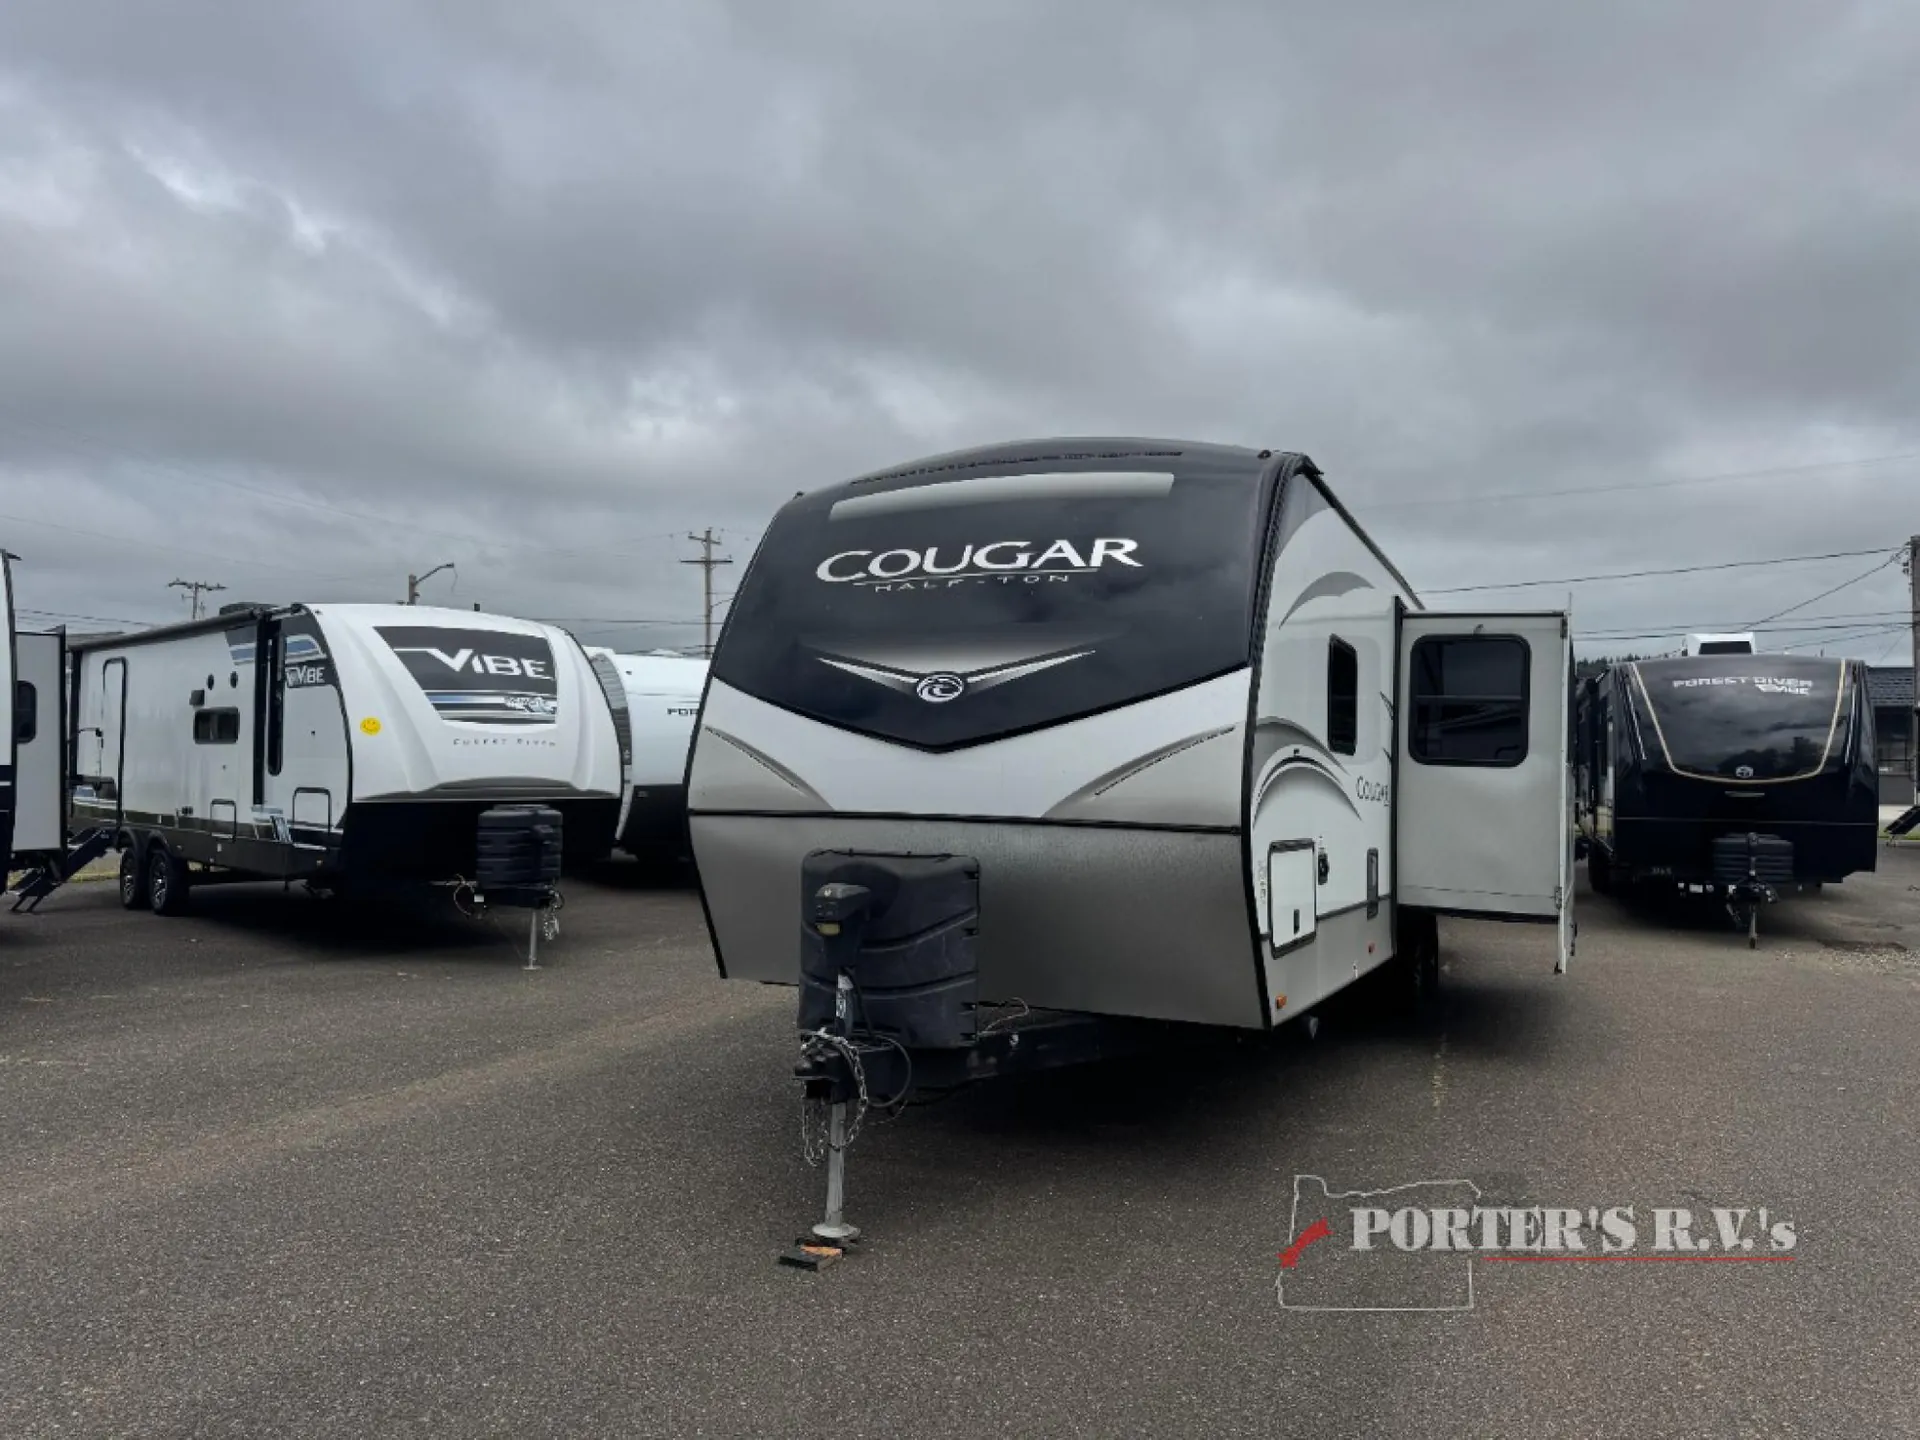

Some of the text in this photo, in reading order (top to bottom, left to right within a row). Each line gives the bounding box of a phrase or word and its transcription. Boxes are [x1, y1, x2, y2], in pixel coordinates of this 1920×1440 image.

[816, 538, 1144, 583] COUGAR
[874, 574, 1070, 593] HALF-TON
[426, 648, 554, 681] VIBE
[1672, 676, 1813, 688] FOREST RIVER
